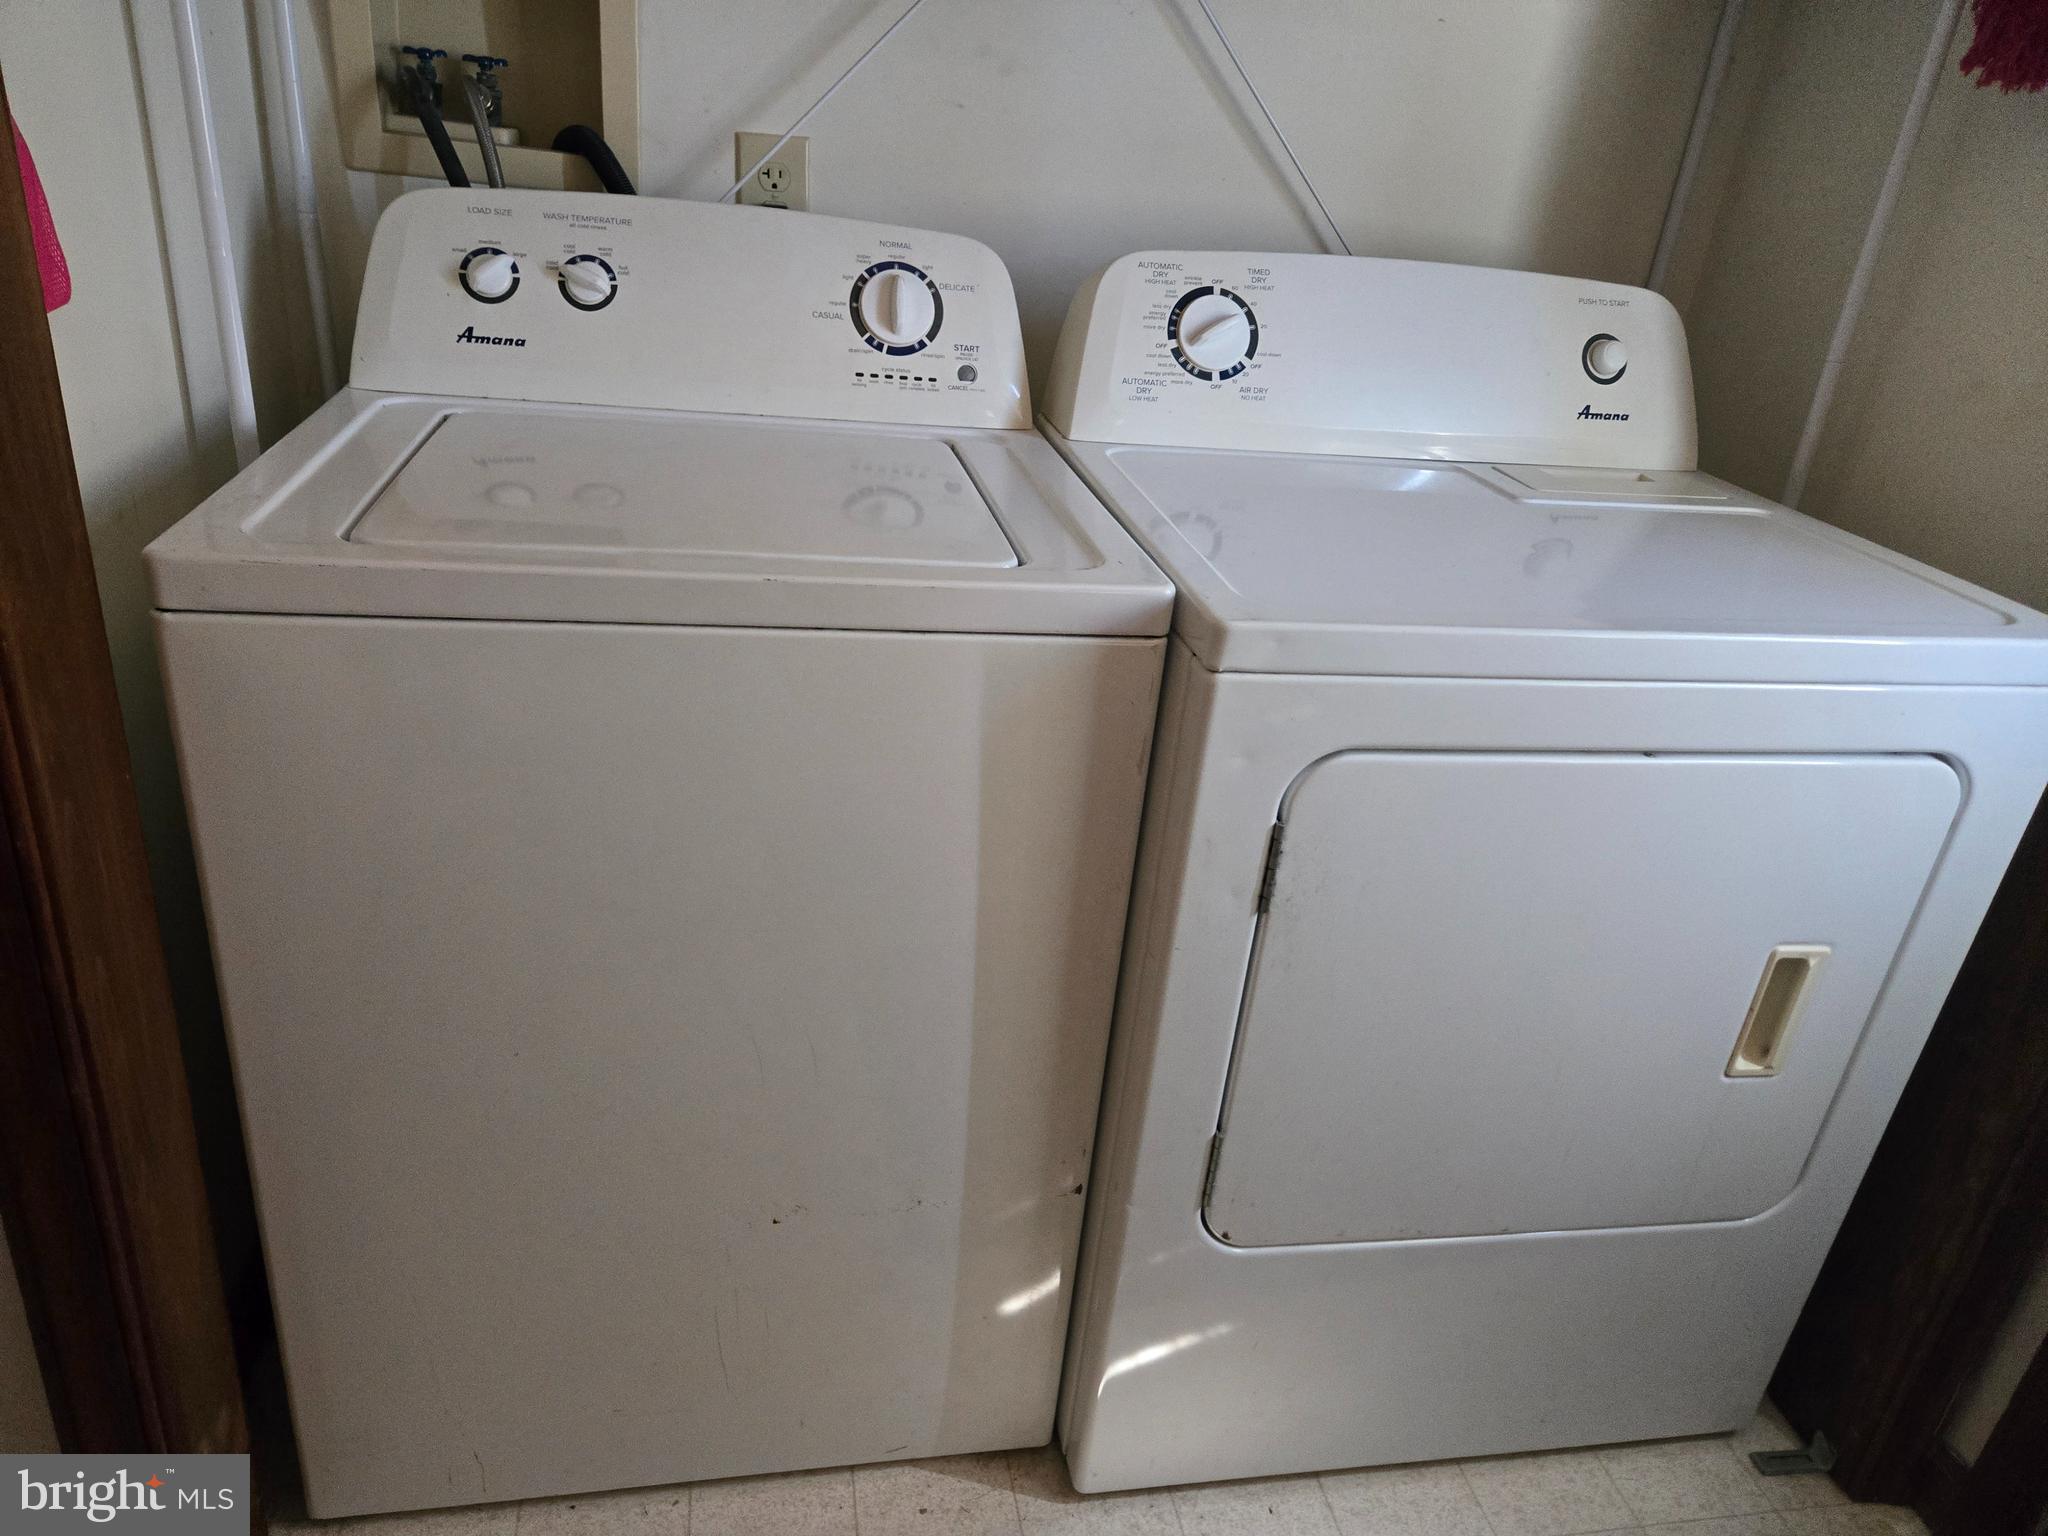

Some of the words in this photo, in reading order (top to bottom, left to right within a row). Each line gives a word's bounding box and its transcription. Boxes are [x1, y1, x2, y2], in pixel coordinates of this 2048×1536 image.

[467, 206, 492, 215] LOAD
[494, 207, 513, 216] SIZE
[542, 212, 569, 220] WASH
[571, 214, 632, 226] TEMPERATURE
[879, 239, 912, 250] NORMAL
[1138, 261, 1183, 271] AUTOMATIC
[1152, 270, 1169, 278] DRY
[1248, 268, 1270, 276] TIMED
[1251, 276, 1267, 284] DRY
[938, 282, 976, 293] DELICATE
[1578, 298, 1597, 306] PUSH
[812, 311, 845, 320] CASUAL
[456, 326, 526, 347] Amana
[953, 344, 980, 353] START
[1122, 377, 1168, 388] AUTOMATIC
[1136, 386, 1152, 394] DRY
[1577, 404, 1630, 421] Amana
